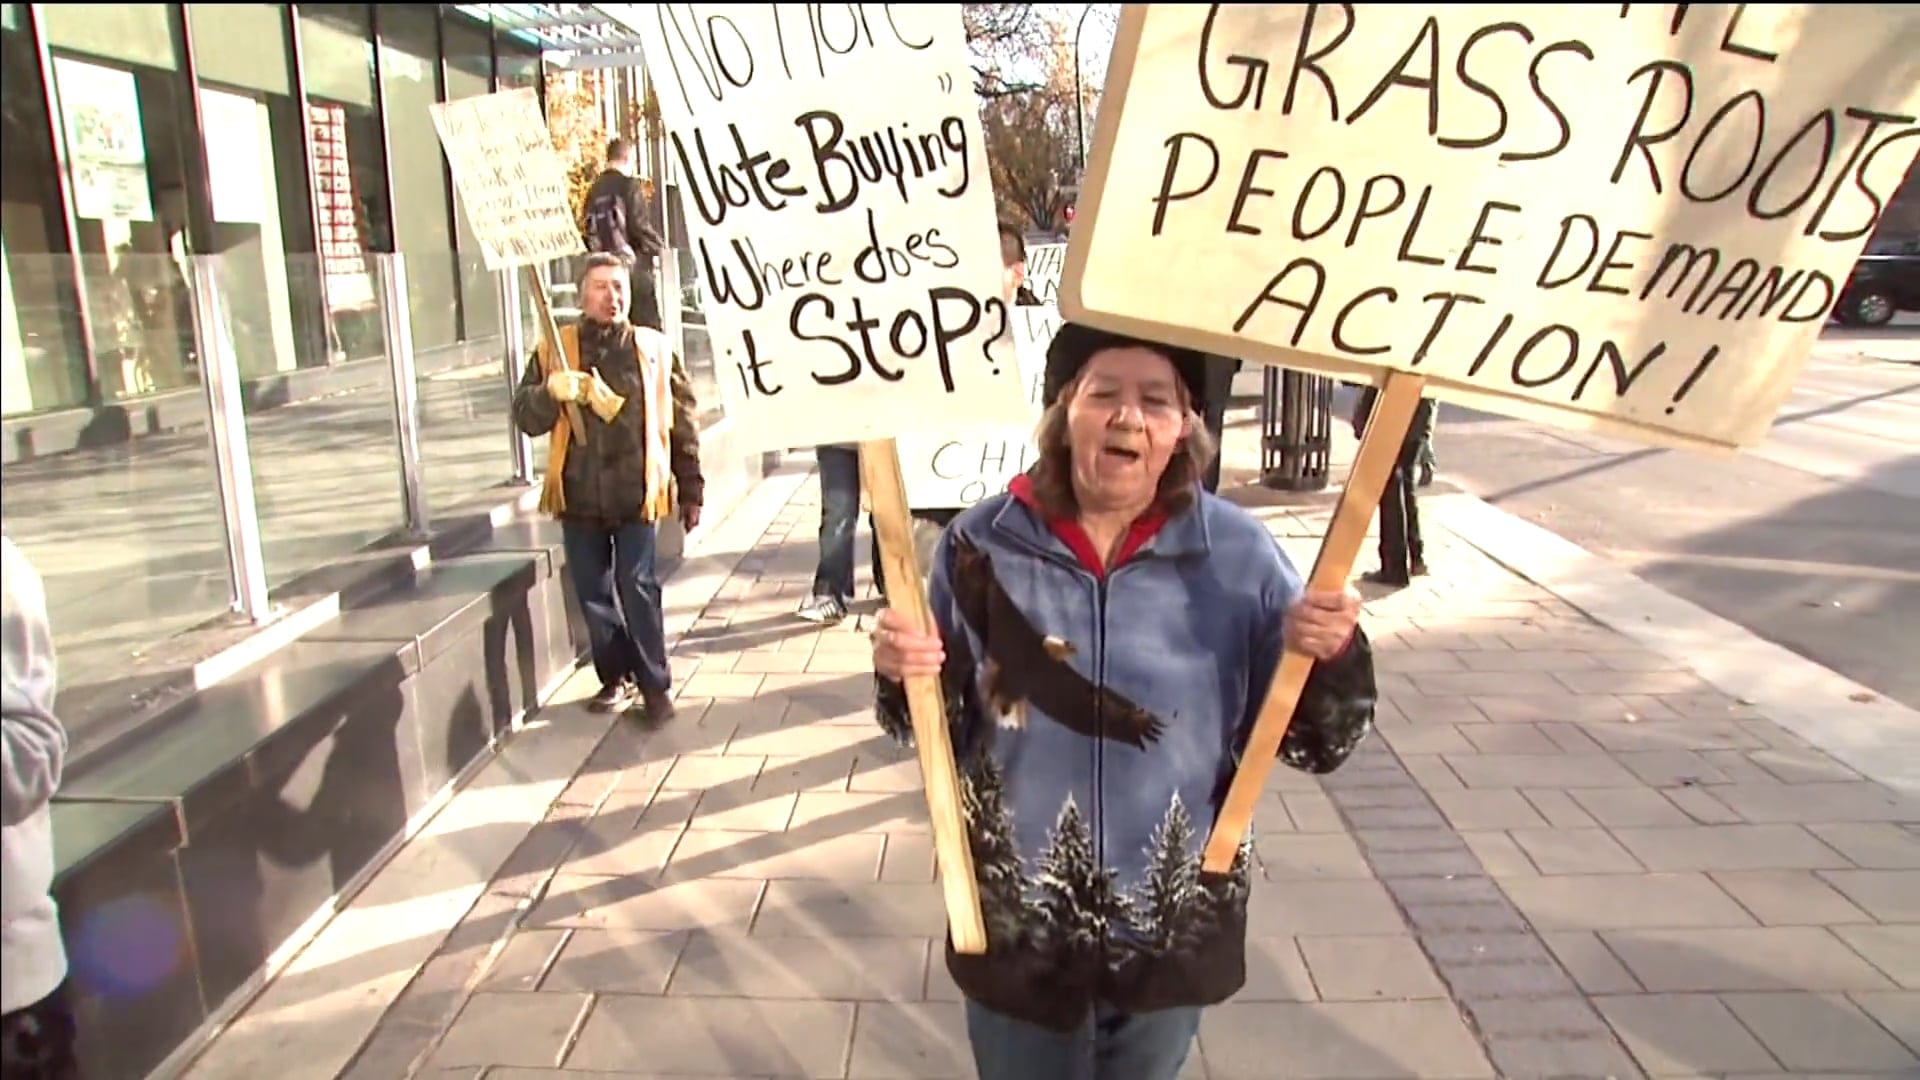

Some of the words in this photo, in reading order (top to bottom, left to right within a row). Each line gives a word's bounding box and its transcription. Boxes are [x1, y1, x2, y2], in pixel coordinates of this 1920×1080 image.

[657, 3, 754, 116] No
[671, 123, 808, 226] Vote
[795, 110, 969, 214] Buying
[1199, 3, 1594, 161] GRASS
[1610, 60, 1920, 242] ROOTS
[699, 237, 842, 310] Where
[853, 208, 959, 284] does
[1152, 132, 1522, 275] PEOPLE
[1536, 214, 1834, 323] DEMAND
[726, 330, 783, 400] it
[1232, 257, 1719, 415] ACTION!
